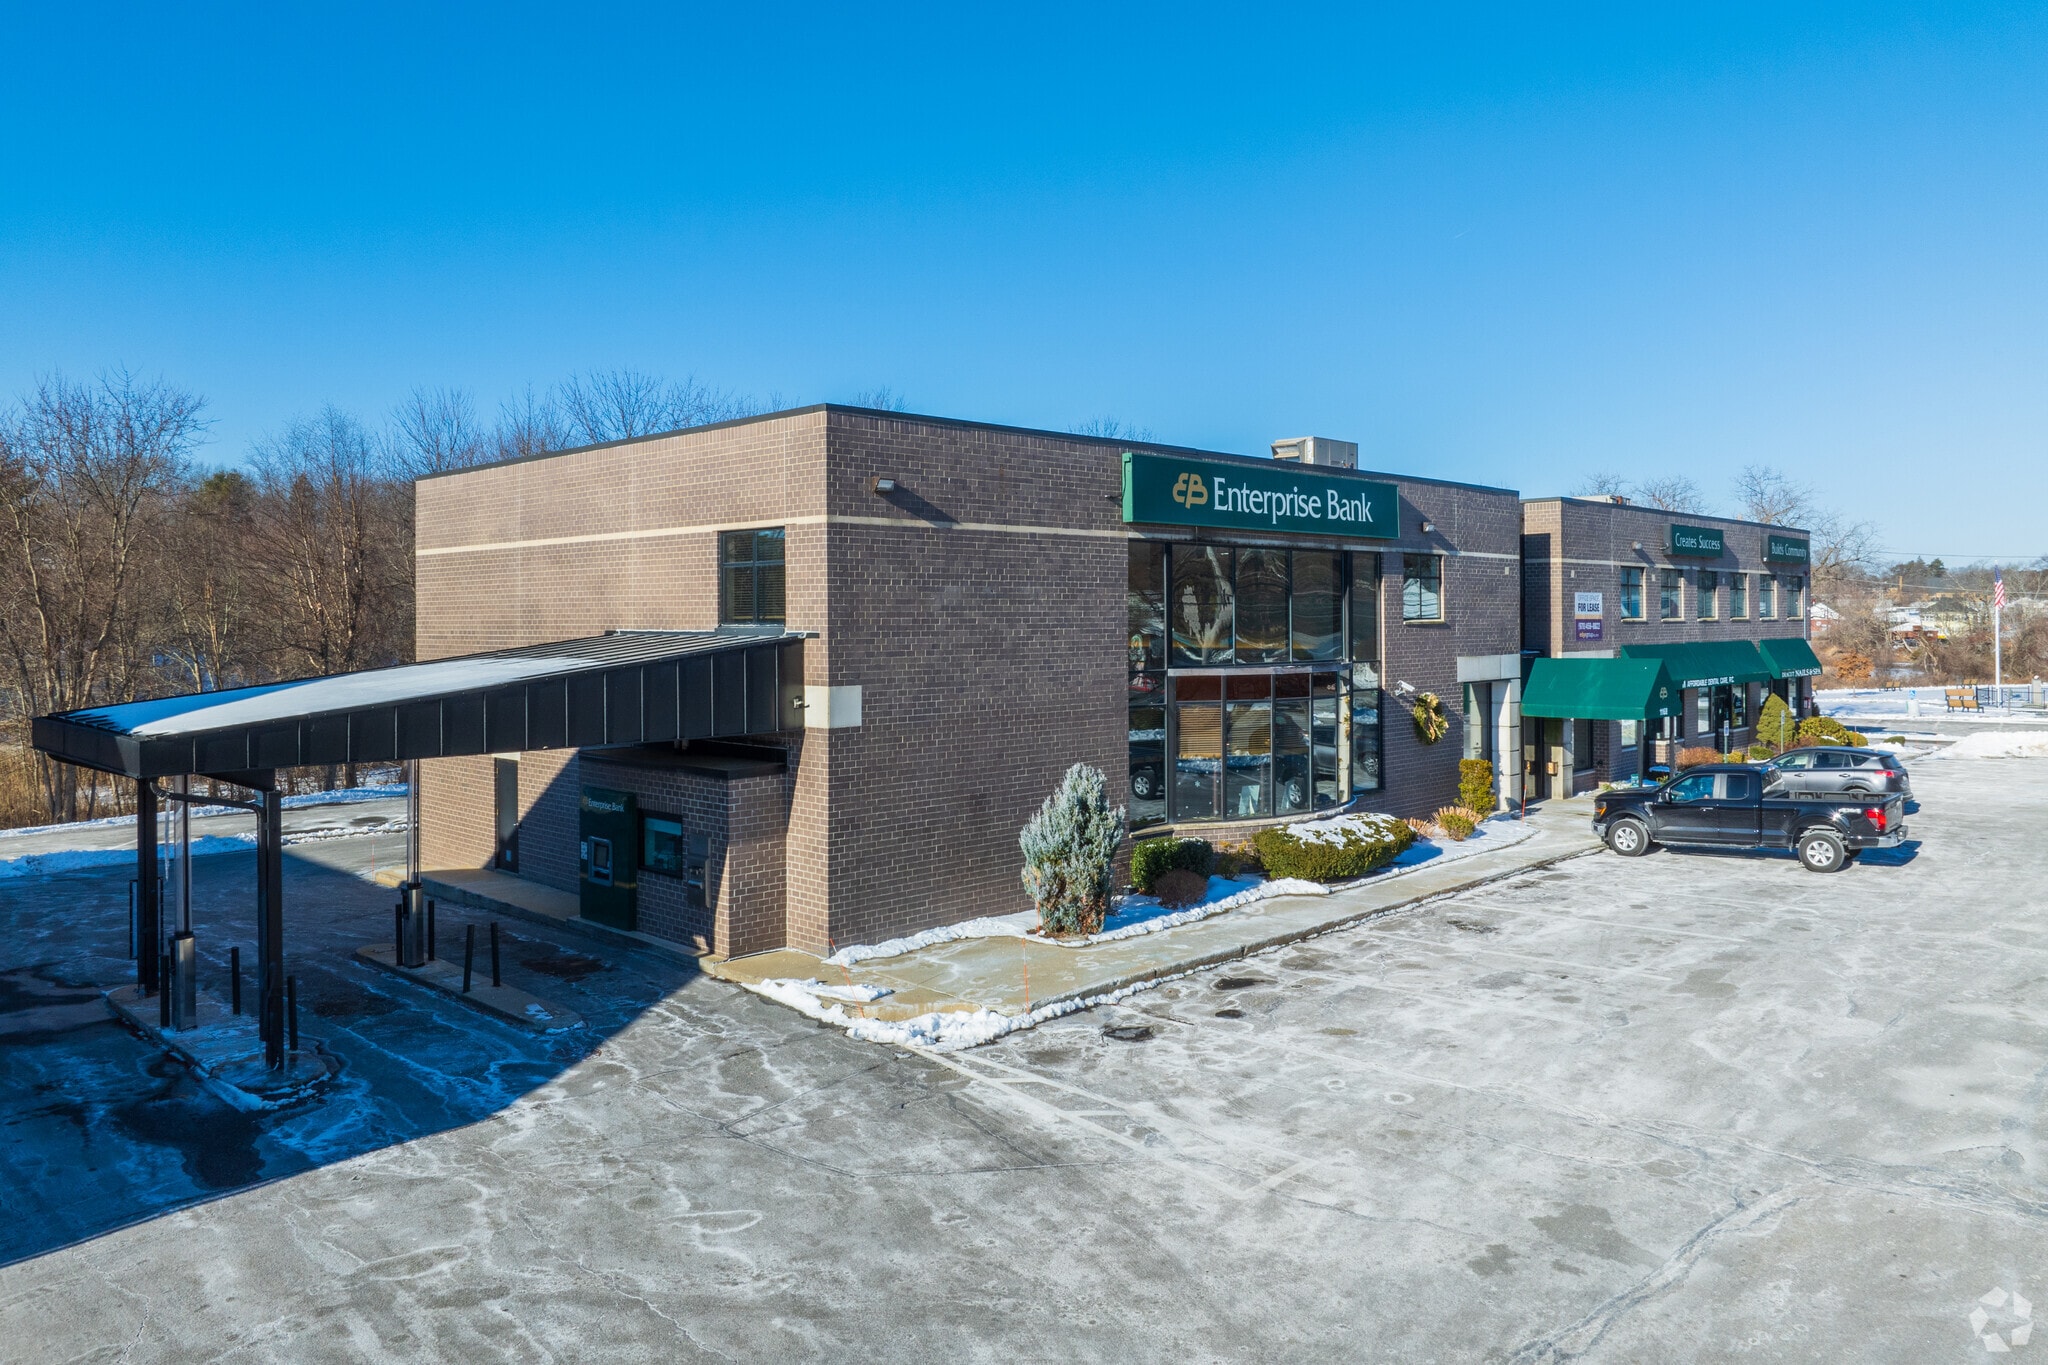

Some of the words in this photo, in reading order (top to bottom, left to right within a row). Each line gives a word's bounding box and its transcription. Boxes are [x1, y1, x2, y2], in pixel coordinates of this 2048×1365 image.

[1213, 477, 1321, 524] Enterprise
[1327, 489, 1373, 523] Bank
[1675, 533, 1697, 548] Creates
[1698, 535, 1721, 550] Success
[1771, 542, 1785, 556] Builds
[1785, 544, 1807, 561] Community
[1578, 603, 1586, 612] FOR
[1587, 603, 1600, 612] LEASE
[1795, 668, 1809, 677] NAILS
[1687, 679, 1707, 688] AFFORDABLE
[588, 798, 611, 811] Enterprise
[612, 802, 624, 812] Bank
